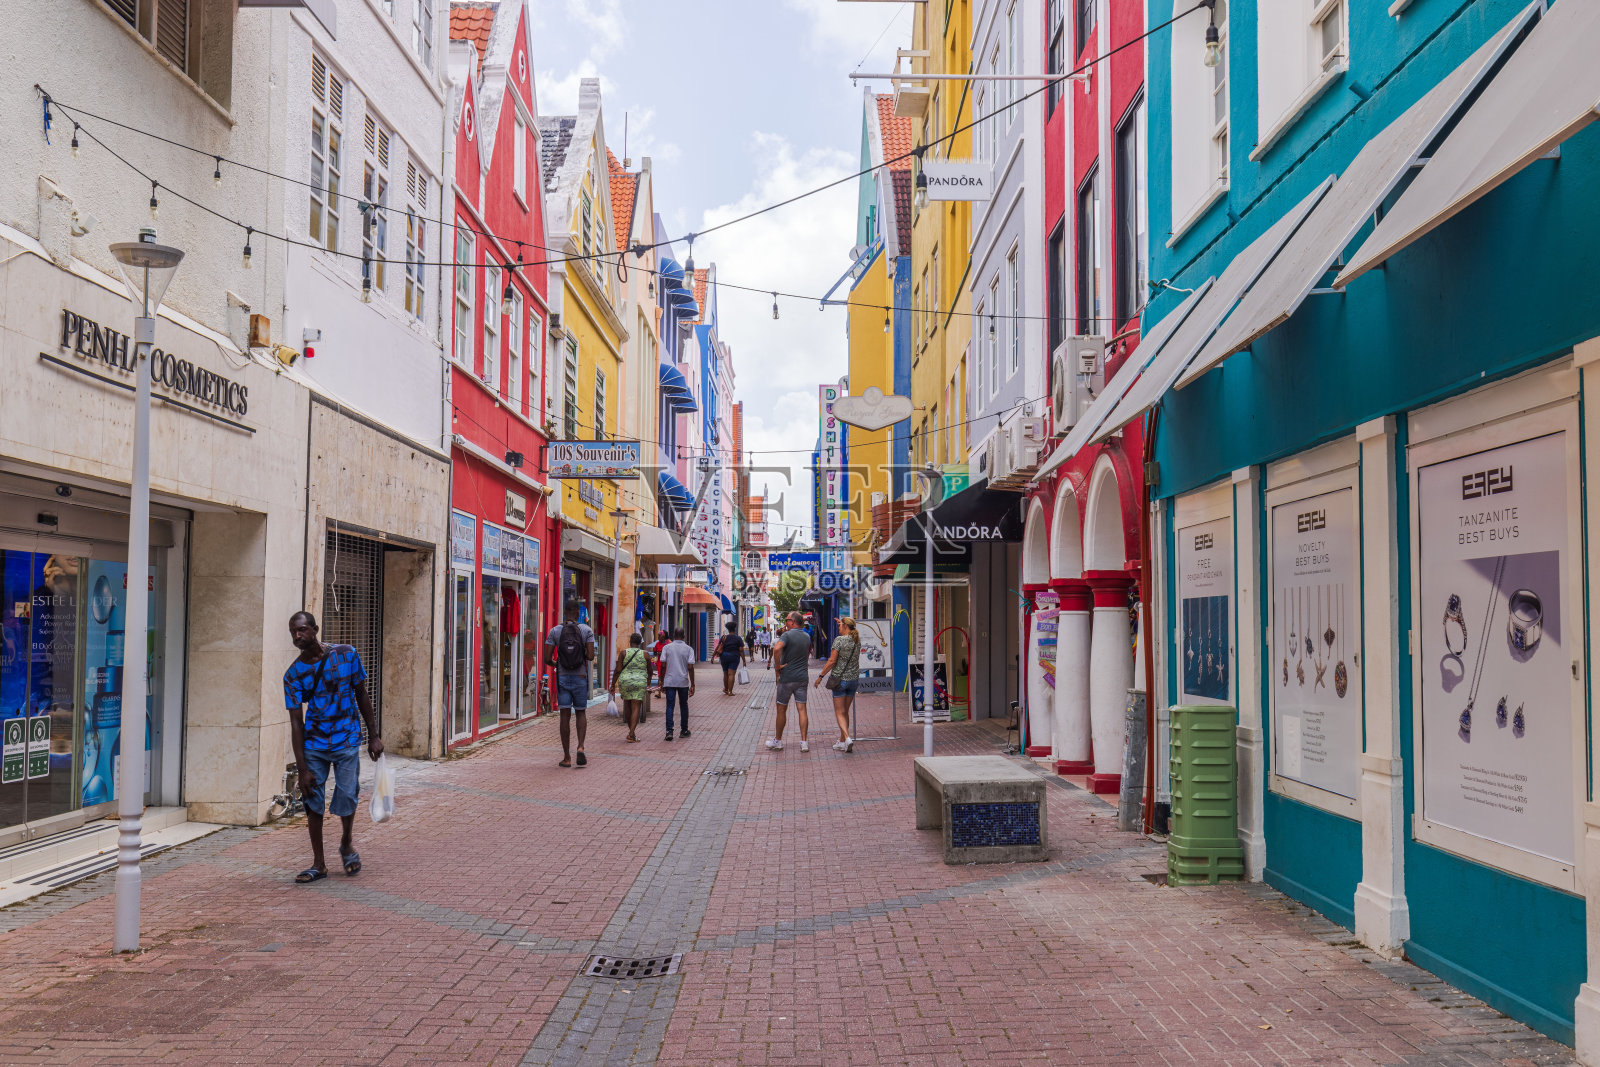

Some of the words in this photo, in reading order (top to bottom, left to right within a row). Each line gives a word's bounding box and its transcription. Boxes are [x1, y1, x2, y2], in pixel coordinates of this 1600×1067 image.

[929, 175, 983, 186] PANDORA
[150, 348, 249, 416] COSMETICS
[553, 444, 573, 462] 10$
[576, 444, 636, 462] Souvenir's
[712, 459, 721, 566] ELECTRONICS
[826, 470, 837, 539] VIBES
[1458, 507, 1519, 527] TANZANITE
[925, 523, 1003, 539] ANDORA
[1458, 530, 1485, 545] BEST
[1489, 525, 1520, 541] BUYS
[1298, 541, 1326, 553] NOVELTY
[1197, 558, 1212, 569] FREE
[1295, 556, 1311, 567] BEST
[1312, 553, 1330, 565] BUYS
[858, 680, 892, 689] ANDORA
